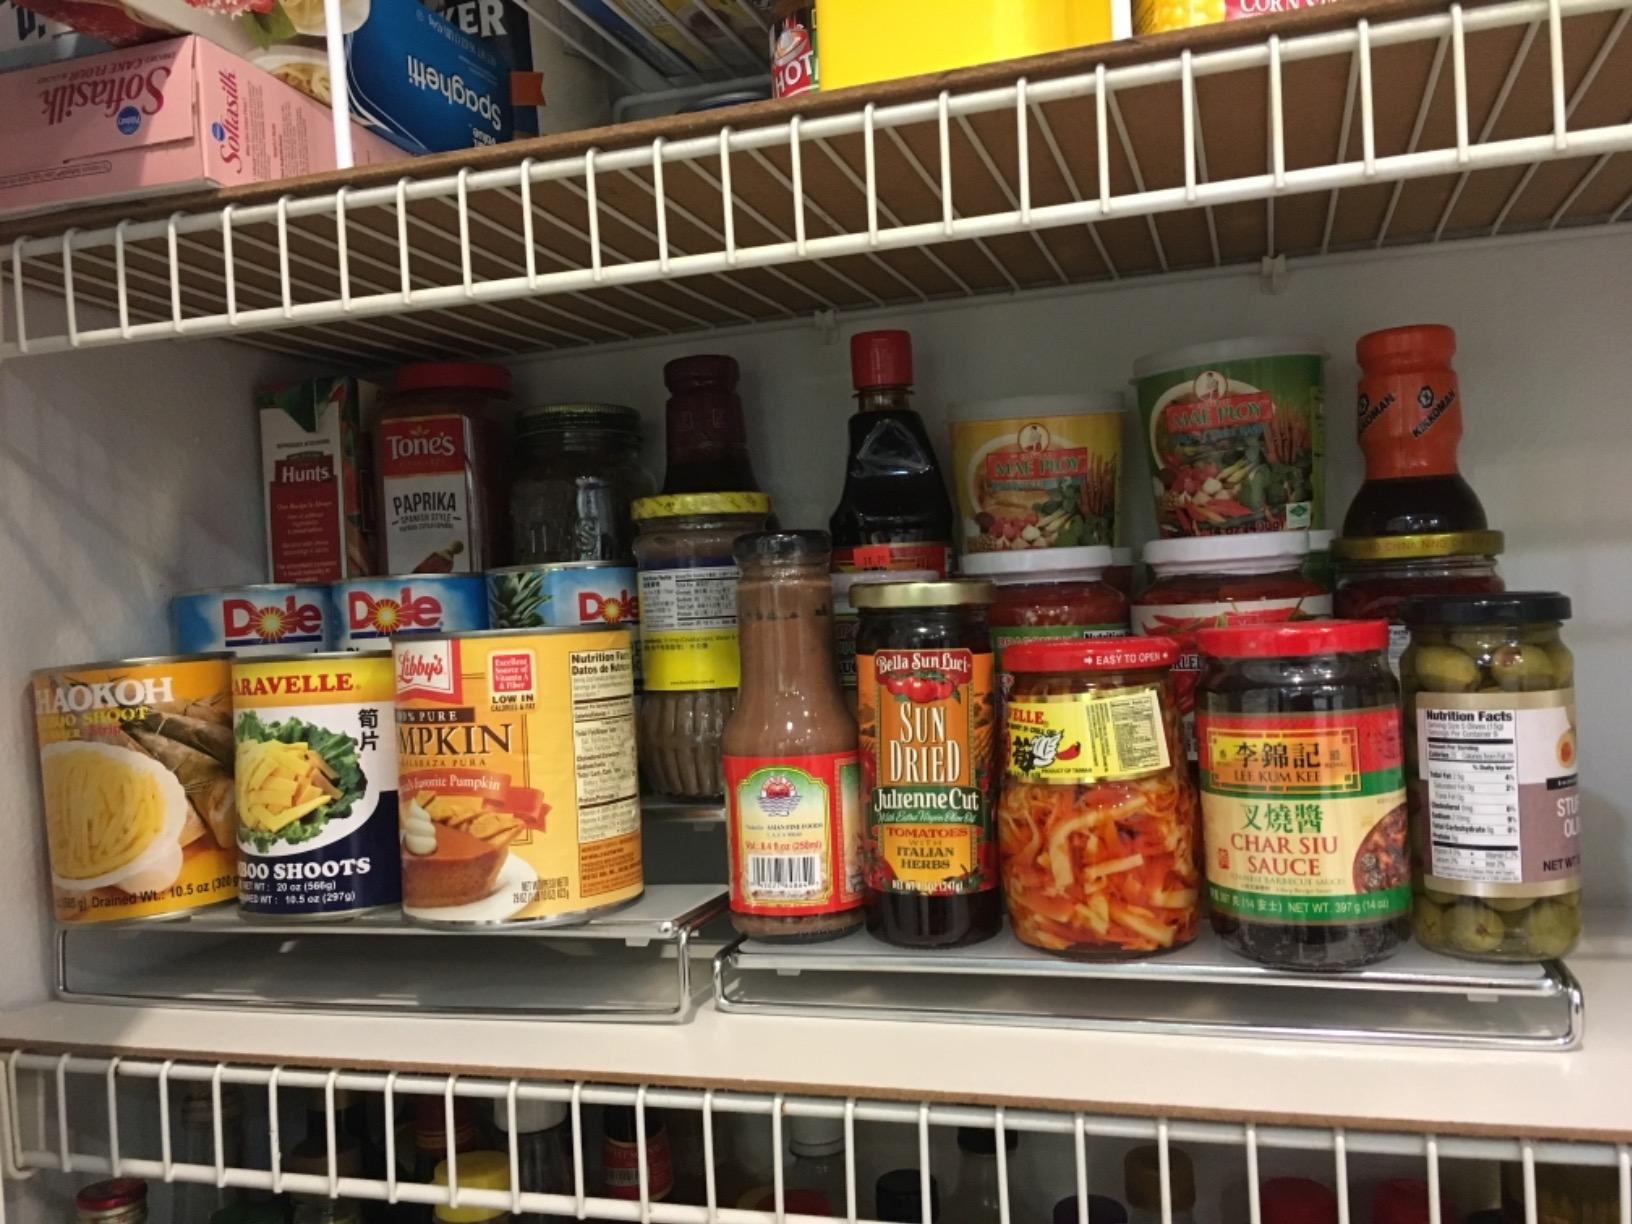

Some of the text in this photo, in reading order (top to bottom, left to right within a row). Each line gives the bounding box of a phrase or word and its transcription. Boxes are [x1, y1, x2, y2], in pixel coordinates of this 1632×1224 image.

[41, 66, 171, 126] Softasilk
[407, 54, 502, 132] Spaghetti
[218, 70, 242, 174] Softasilk
[386, 432, 456, 460] Tone's
[393, 491, 456, 516] PAPRIKA
[223, 595, 322, 641] Dole
[348, 588, 442, 632] Dole
[398, 650, 444, 684] Libby's
[571, 652, 615, 664] Nutrition
[876, 652, 968, 675] Bella Sun Luci
[1096, 648, 1161, 665] EASY TO OPEN
[492, 693, 534, 704] LOW IN
[418, 710, 459, 722] PURE
[899, 701, 947, 744] SUN
[1427, 709, 1513, 722] Nutrition Facts
[357, 707, 381, 751] 筍片
[889, 739, 960, 782] DRIED
[1232, 741, 1321, 769] 李錦記
[448, 774, 501, 791] Pumpkin
[1234, 770, 1322, 783] LEE KUM KEE
[874, 788, 979, 812] Julienne Cut
[1240, 803, 1324, 834] 叉燒醬
[1446, 823, 1486, 833] Carbohydrate
[886, 826, 969, 839] TOMATOES
[1229, 832, 1339, 855] CHAR SIU
[897, 846, 955, 858] ITALIAN
[273, 857, 372, 881] SHOOTS
[901, 858, 951, 870] HERBS
[1246, 856, 1322, 878] SAUCE
[1542, 858, 1564, 872] NET
[91, 893, 138, 909] Drained
[170, 884, 193, 899] 10.5
[197, 882, 209, 894] oz
[276, 882, 288, 892] 20
[1288, 901, 1309, 914] NET
[1334, 903, 1352, 914] 397
